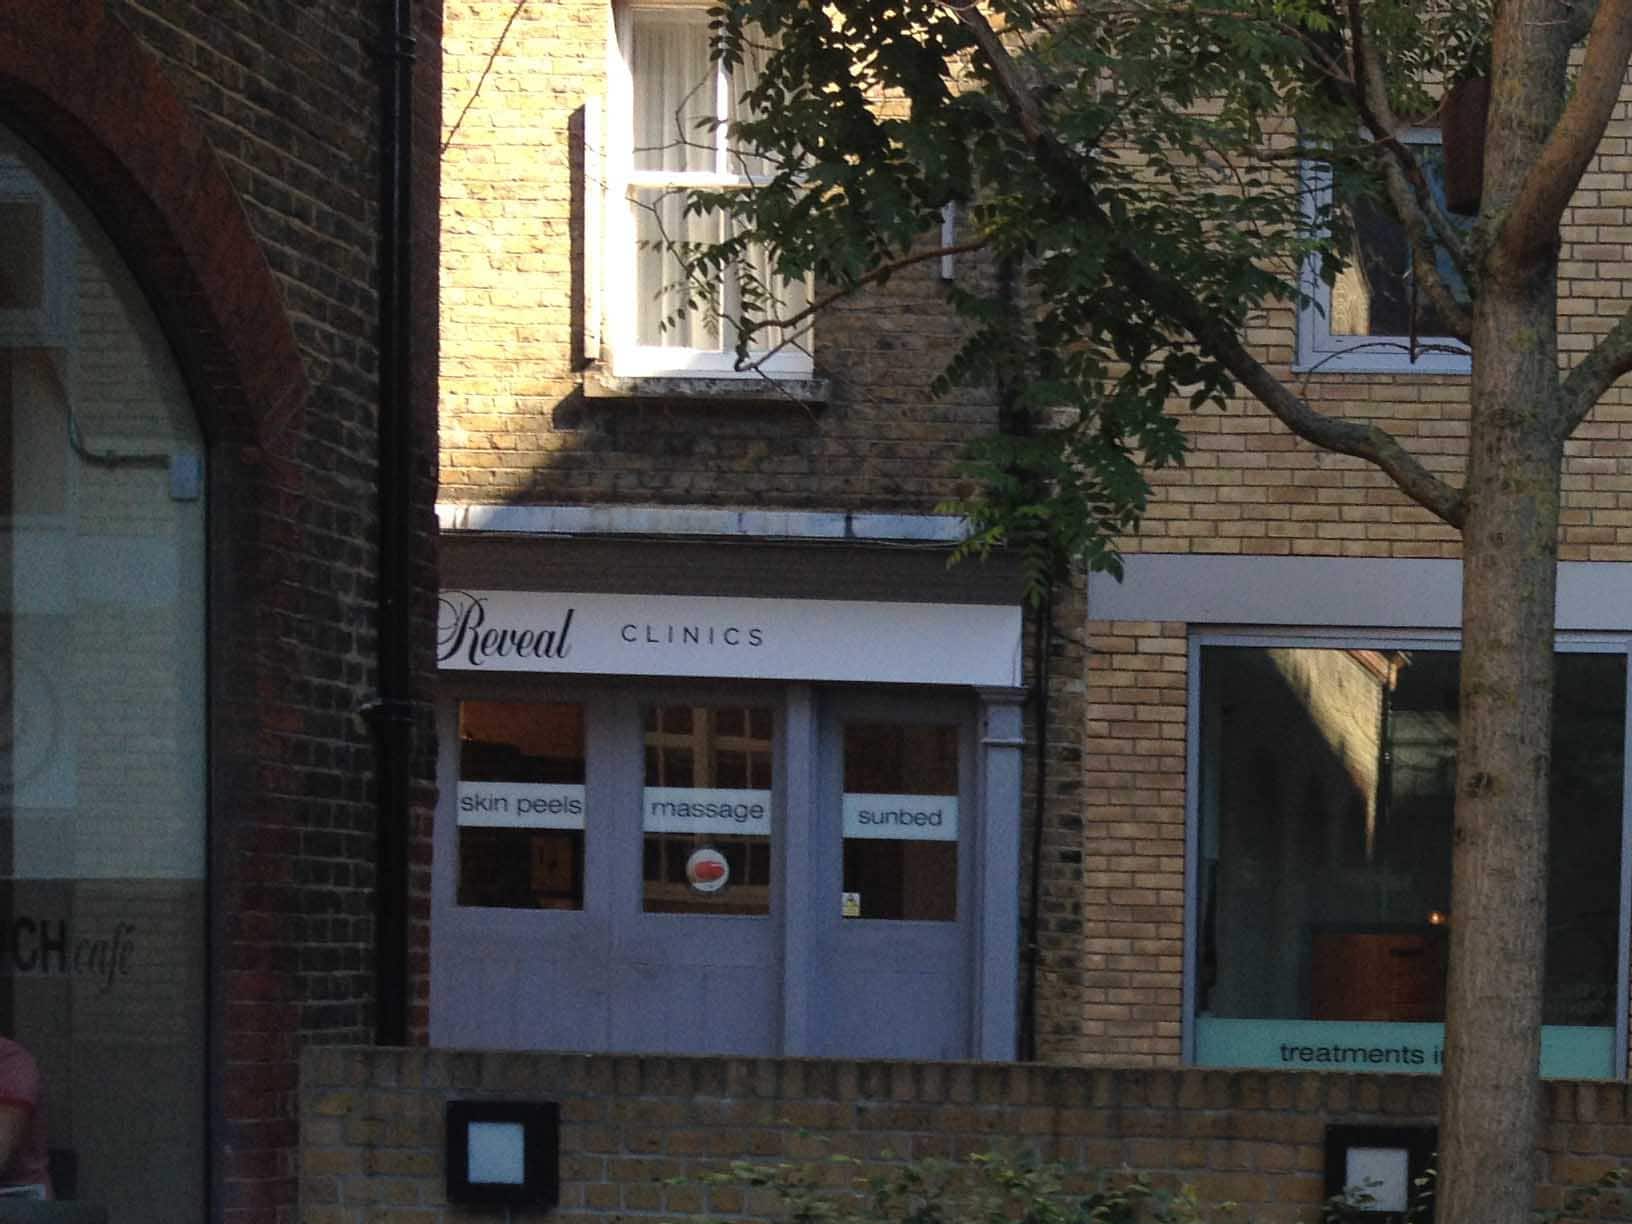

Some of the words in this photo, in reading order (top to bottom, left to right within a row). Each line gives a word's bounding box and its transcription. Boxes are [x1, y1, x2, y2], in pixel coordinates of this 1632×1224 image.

[437, 591, 575, 665] Reveal
[621, 623, 764, 647] CLINICS
[460, 793, 508, 812] skin
[516, 795, 583, 817] peels
[650, 802, 765, 823] massage
[857, 807, 943, 827] sunbed
[0, 916, 66, 974] CH
[1280, 1043, 1425, 1065] treatments
